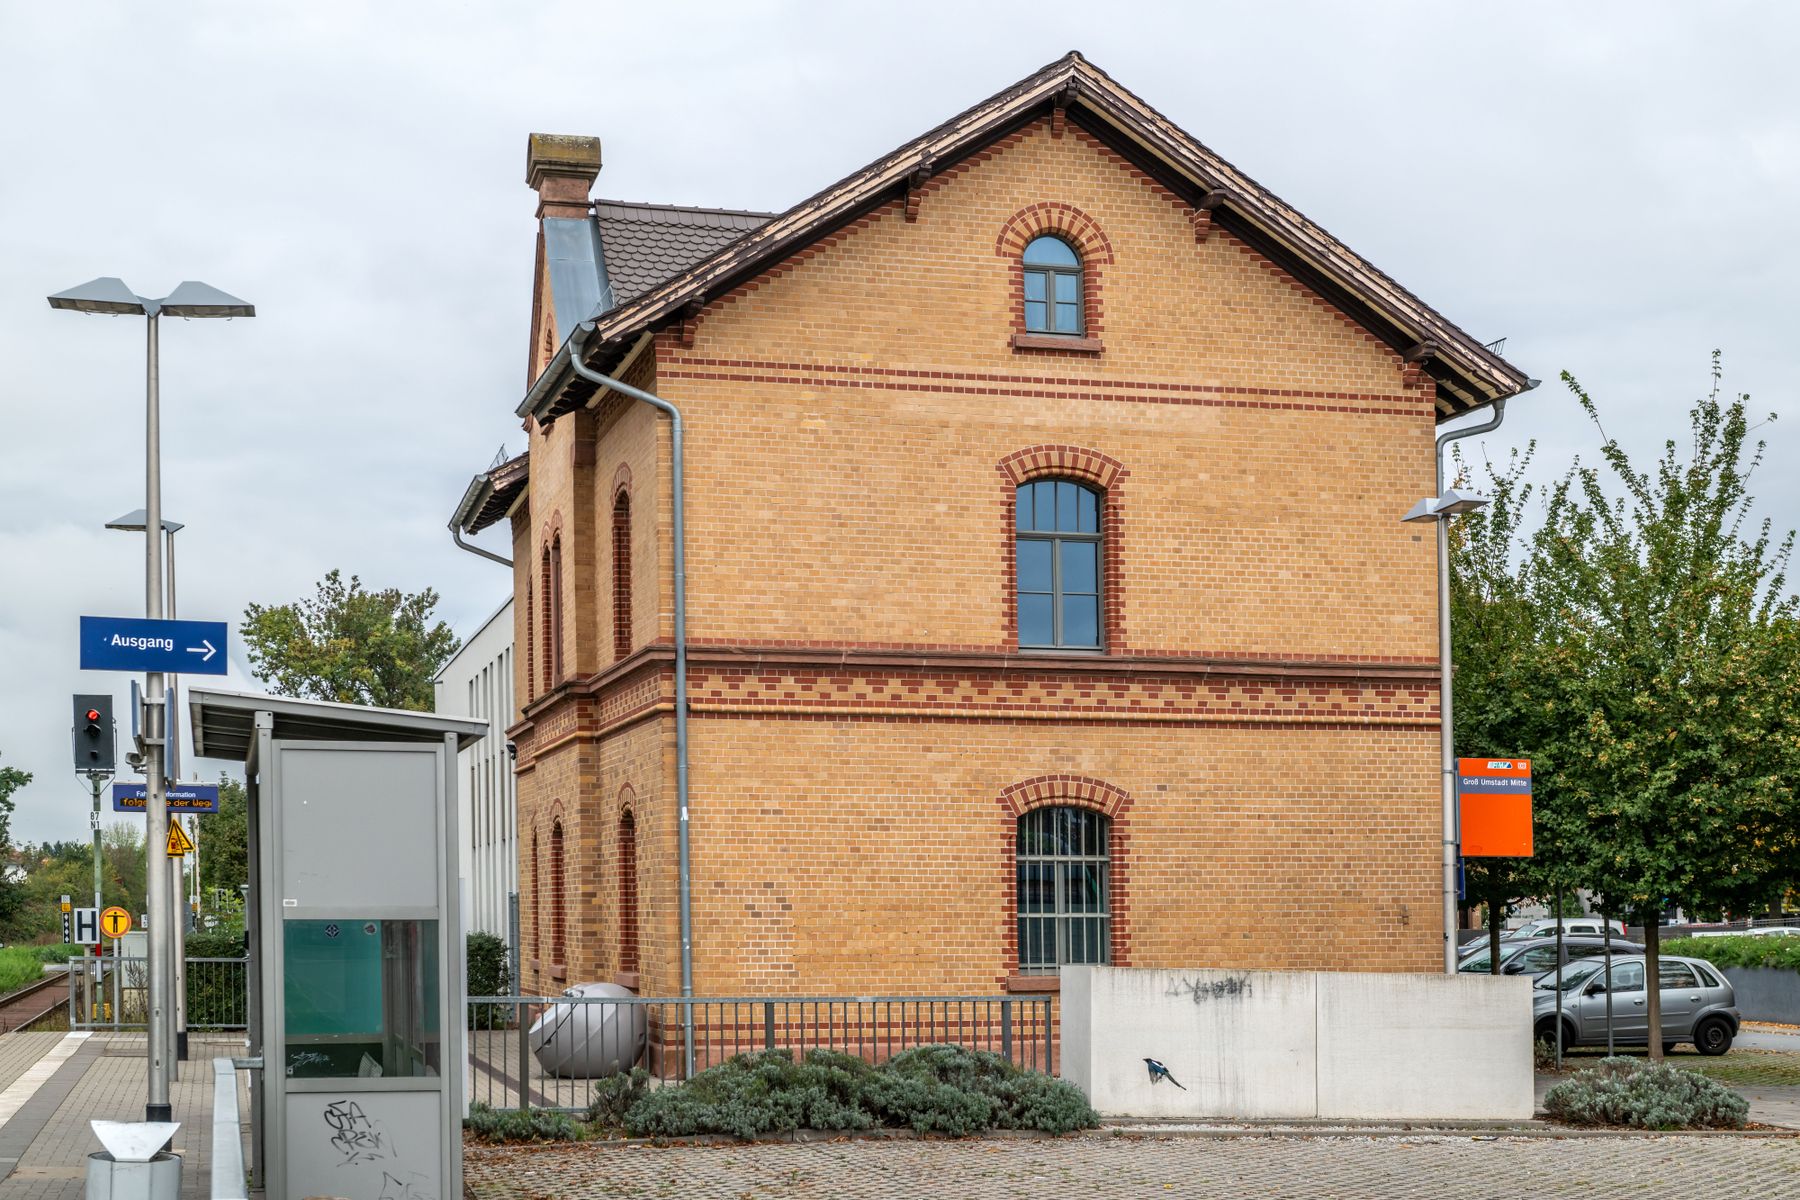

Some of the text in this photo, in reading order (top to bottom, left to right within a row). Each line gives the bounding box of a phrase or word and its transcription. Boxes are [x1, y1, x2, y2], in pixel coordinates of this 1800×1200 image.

[111, 634, 173, 651] Ausgang
[1463, 778, 1478, 786] Groß
[1510, 779, 1527, 787] Mitte
[174, 799, 189, 807] der
[192, 800, 212, 808] Weg
[90, 811, 99, 820] 87
[90, 821, 99, 829] N1
[77, 911, 97, 941] H
